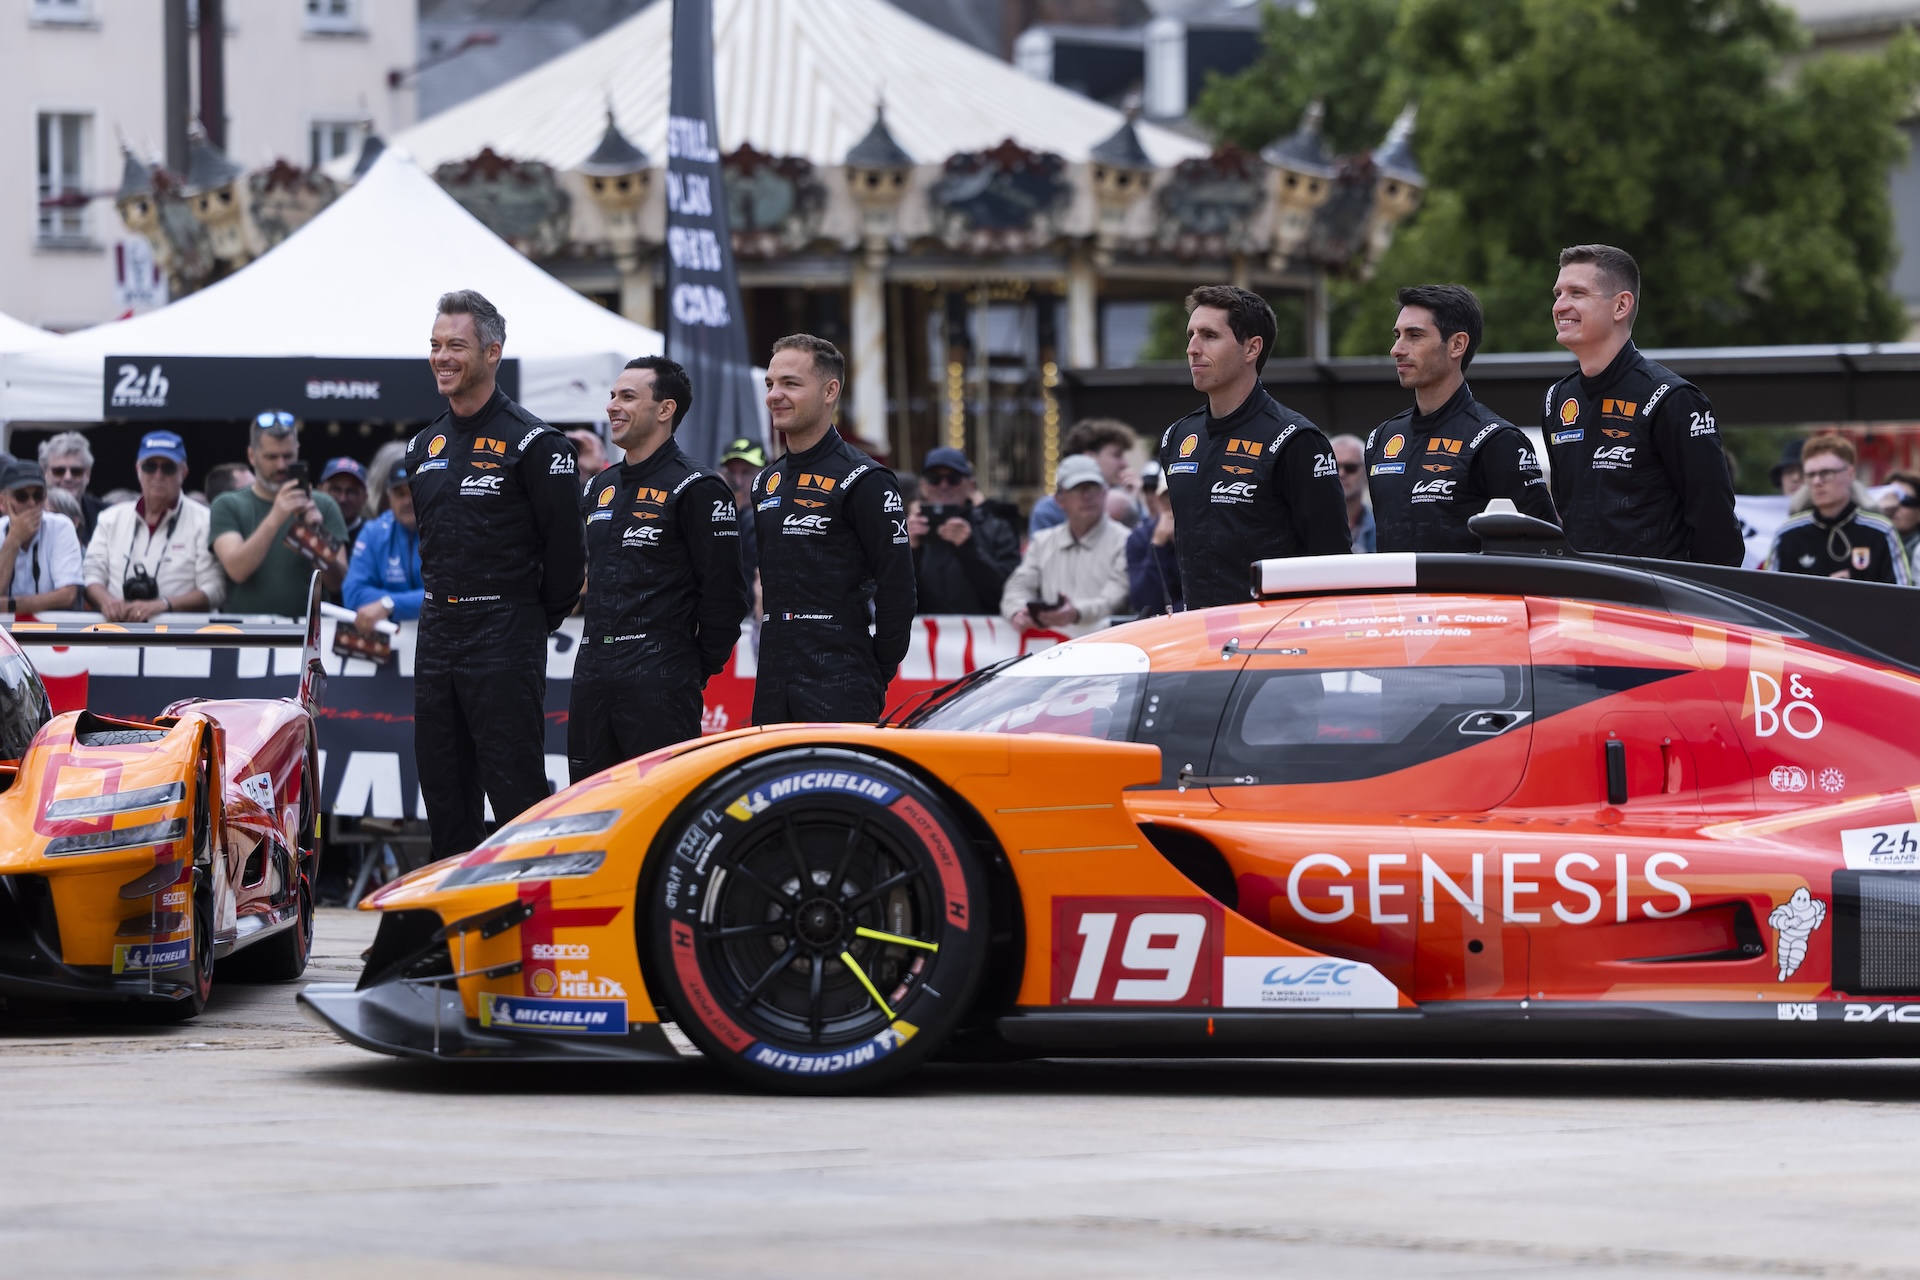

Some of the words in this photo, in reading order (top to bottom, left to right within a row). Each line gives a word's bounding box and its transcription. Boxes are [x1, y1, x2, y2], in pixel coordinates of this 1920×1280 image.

[305, 380, 381, 400] SPARK
[111, 397, 129, 407] LE
[130, 397, 166, 407] MANS
[1642, 383, 1670, 417] sparco
[518, 427, 545, 452] sparco
[1269, 423, 1298, 454] sparco
[1469, 422, 1499, 449] sparco
[1593, 446, 1636, 462] WEC
[460, 475, 504, 489] WEC
[673, 471, 702, 495] sparco
[840, 464, 869, 490] sparco
[1211, 481, 1258, 497] WEC
[1412, 479, 1457, 495] WEC
[783, 513, 832, 529] WEC
[623, 526, 663, 540] WEC
[1338, 616, 1406, 626] Jaminet
[1453, 614, 1508, 623] Chatin
[1384, 628, 1471, 637] Juncadella
[770, 771, 890, 800] MICHELIN
[903, 804, 932, 835] PILOT
[928, 831, 953, 867] SPORT
[1286, 852, 1693, 925] GENESIS
[949, 901, 965, 920] H
[675, 930, 692, 948] H
[144, 948, 187, 965] MICHELIN
[531, 944, 590, 958] sparco
[1069, 912, 1207, 1001] 19
[560, 970, 588, 981] Shell
[1262, 963, 1358, 985] WEC
[560, 978, 627, 997] HELIX
[515, 1008, 608, 1024] MICHELIN
[689, 981, 716, 1019] SPORT
[709, 1016, 741, 1043] PILOT
[1777, 1003, 1818, 1021] HEXIS
[756, 1043, 876, 1073] MICHELIN
